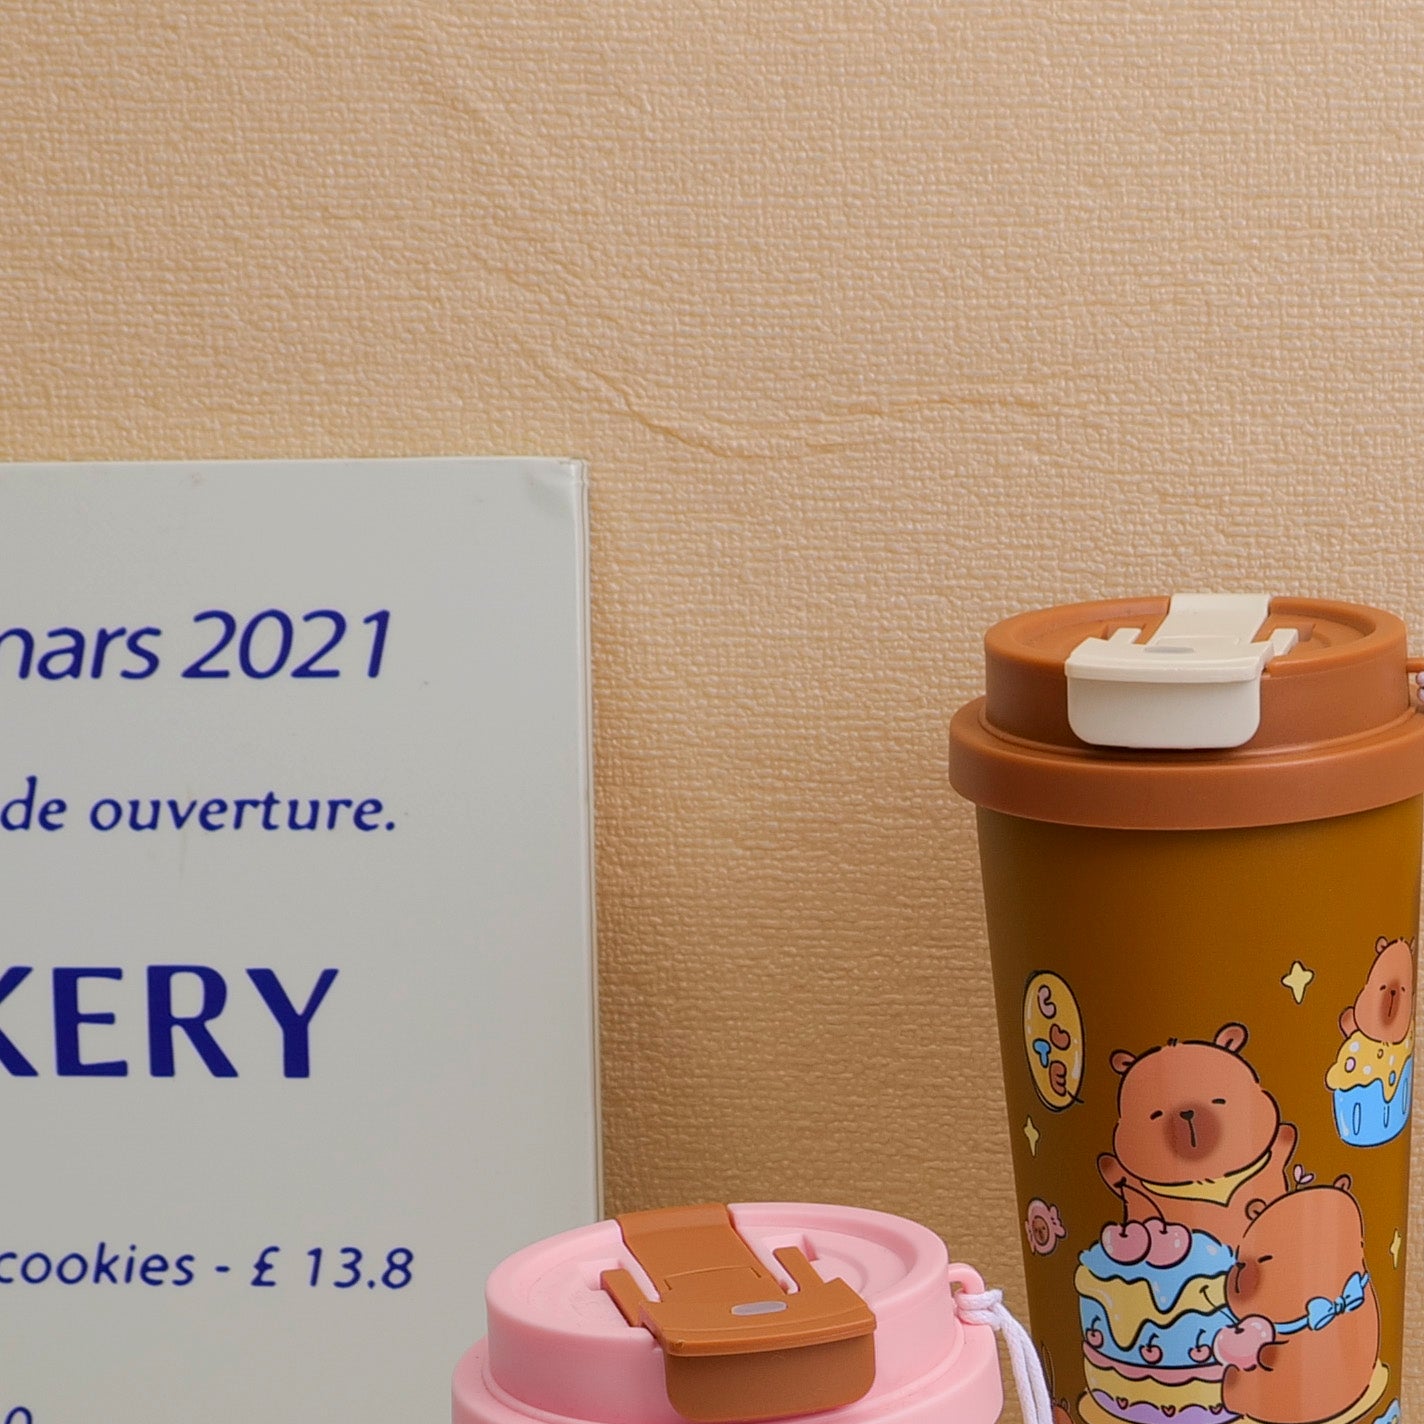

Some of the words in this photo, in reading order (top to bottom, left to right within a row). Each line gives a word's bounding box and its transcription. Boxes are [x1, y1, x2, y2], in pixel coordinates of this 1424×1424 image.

[181, 608, 391, 680] 2021
[0, 774, 67, 832] de
[89, 791, 395, 832] ouverture.
[307, 1246, 414, 1290] 13.8
